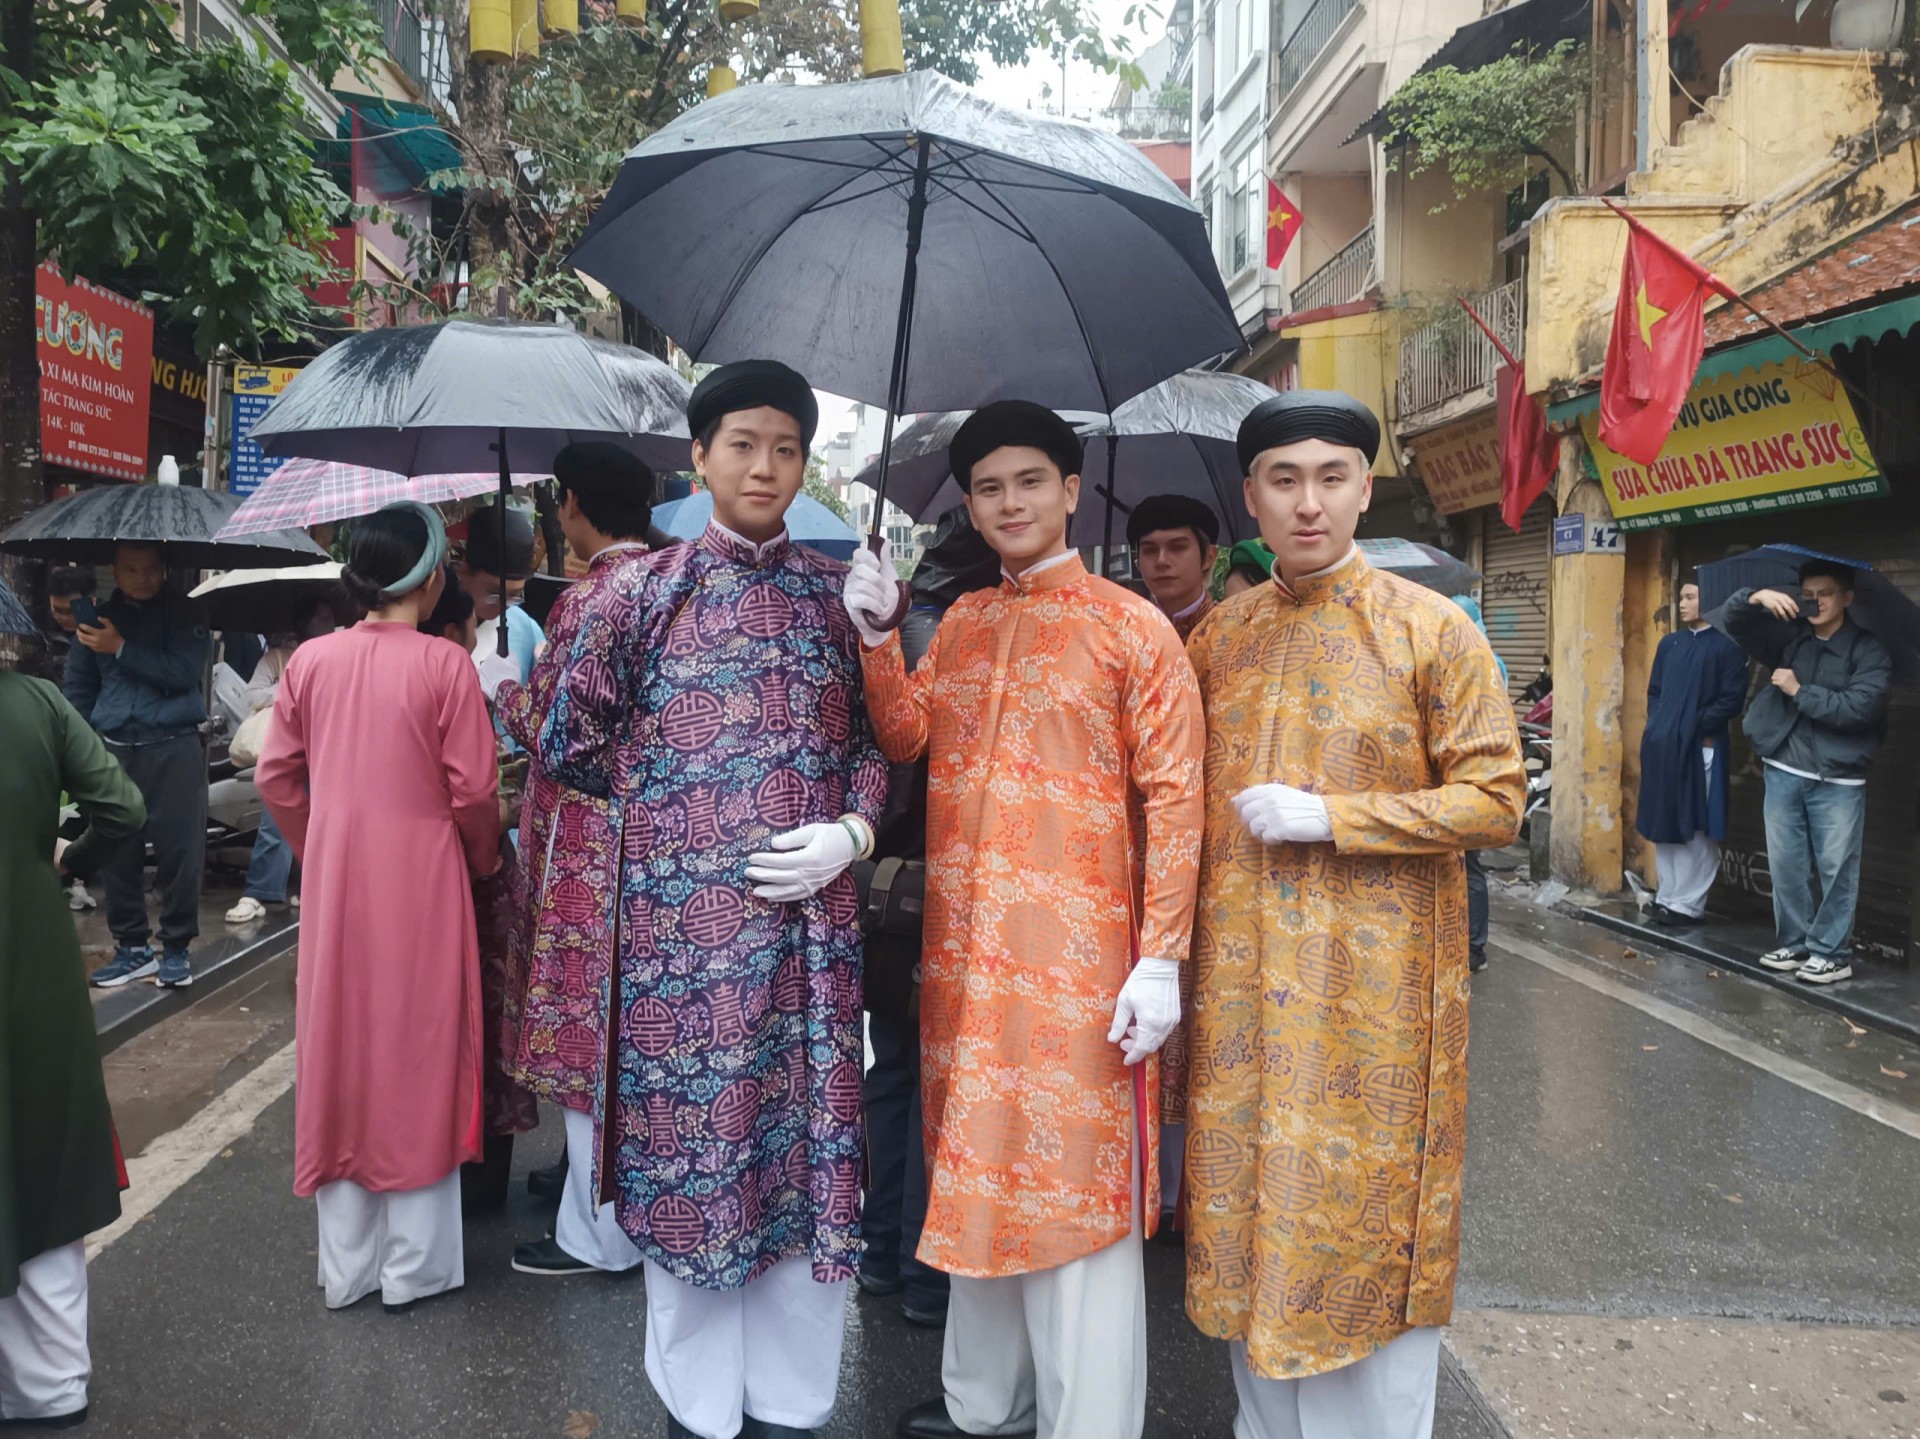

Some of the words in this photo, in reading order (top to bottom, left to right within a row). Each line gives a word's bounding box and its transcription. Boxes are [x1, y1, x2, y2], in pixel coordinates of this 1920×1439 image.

[81, 373, 102, 394] KIM
[42, 387, 61, 406] TÁC
[62, 394, 94, 416] TRANG
[1700, 393, 1735, 422] GIA
[1723, 432, 1807, 480] TRANG
[1591, 526, 1619, 548] 47
